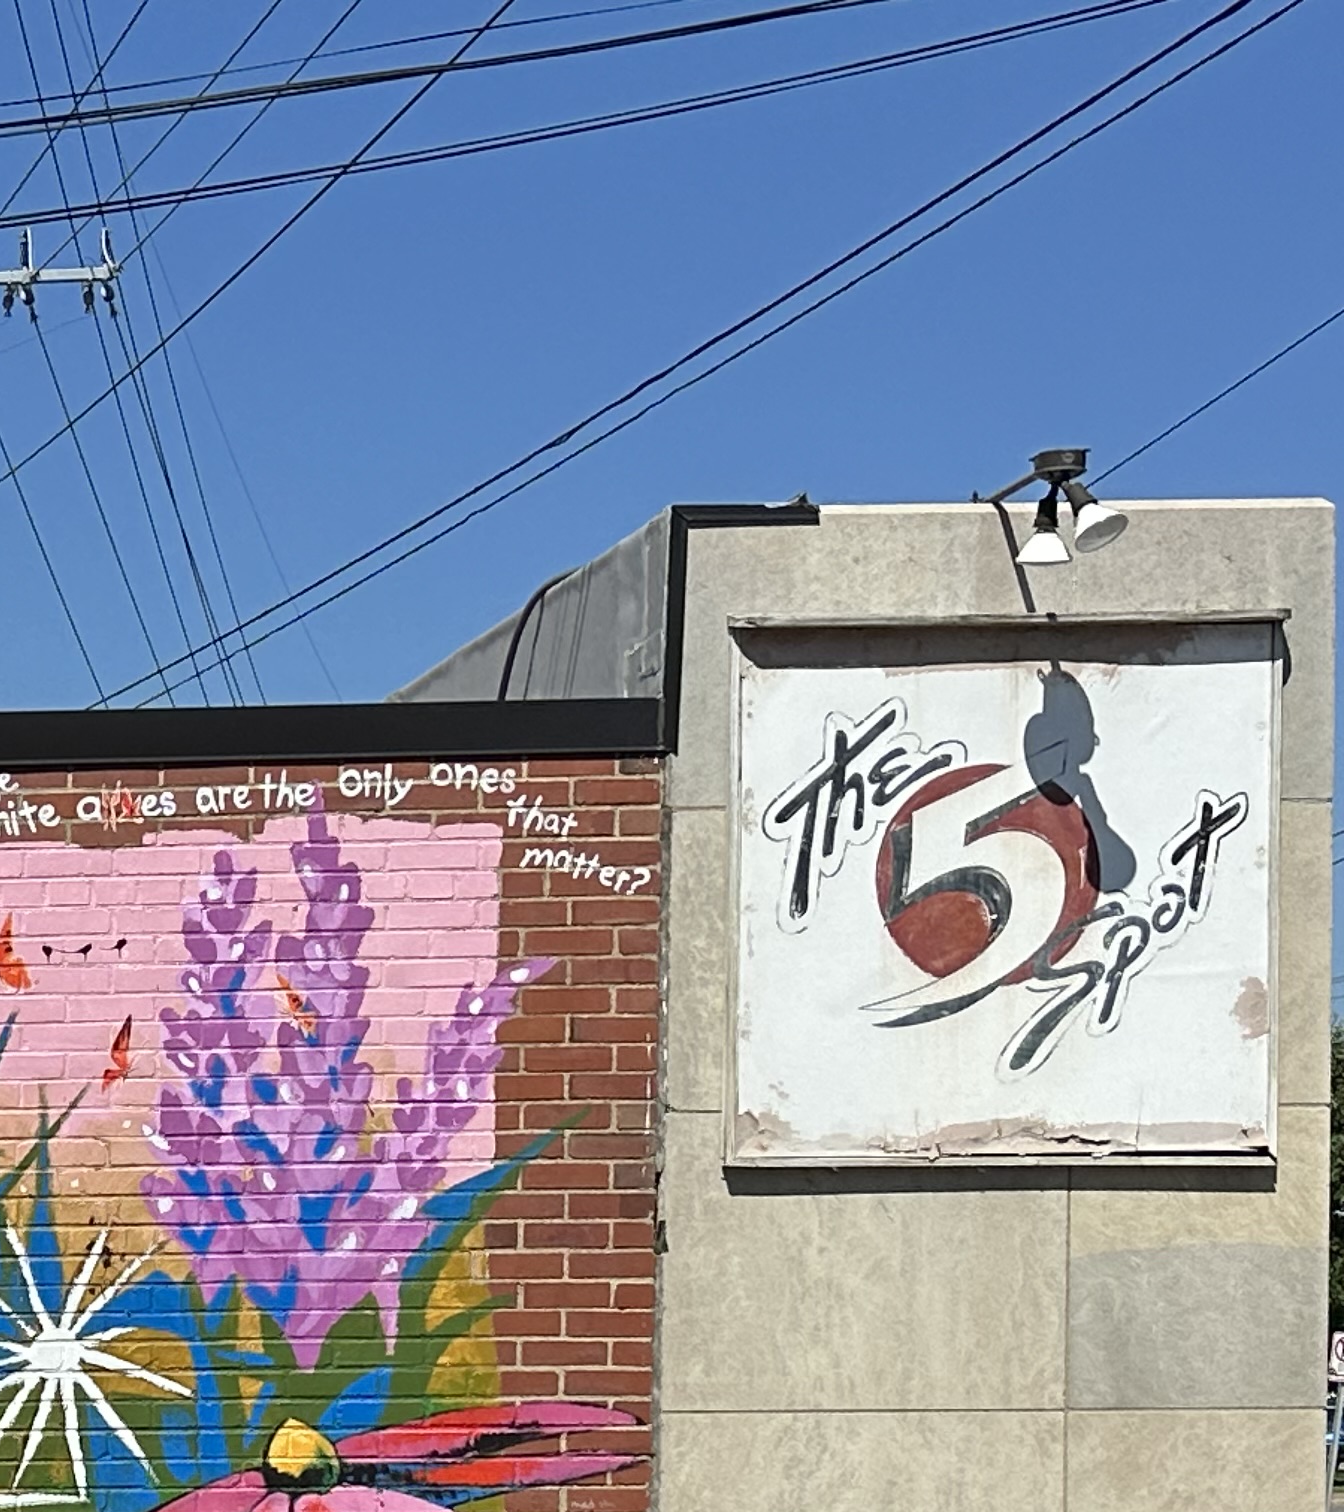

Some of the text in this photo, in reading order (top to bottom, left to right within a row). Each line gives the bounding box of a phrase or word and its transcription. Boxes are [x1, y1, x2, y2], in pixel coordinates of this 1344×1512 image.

[76, 780, 177, 832] aes
[196, 785, 252, 813] are
[261, 770, 316, 808] the
[339, 764, 413, 805] only
[430, 763, 516, 794] ones
[505, 794, 577, 836] that
[519, 847, 652, 895] matter?
[859, 740, 1074, 1028] 5
